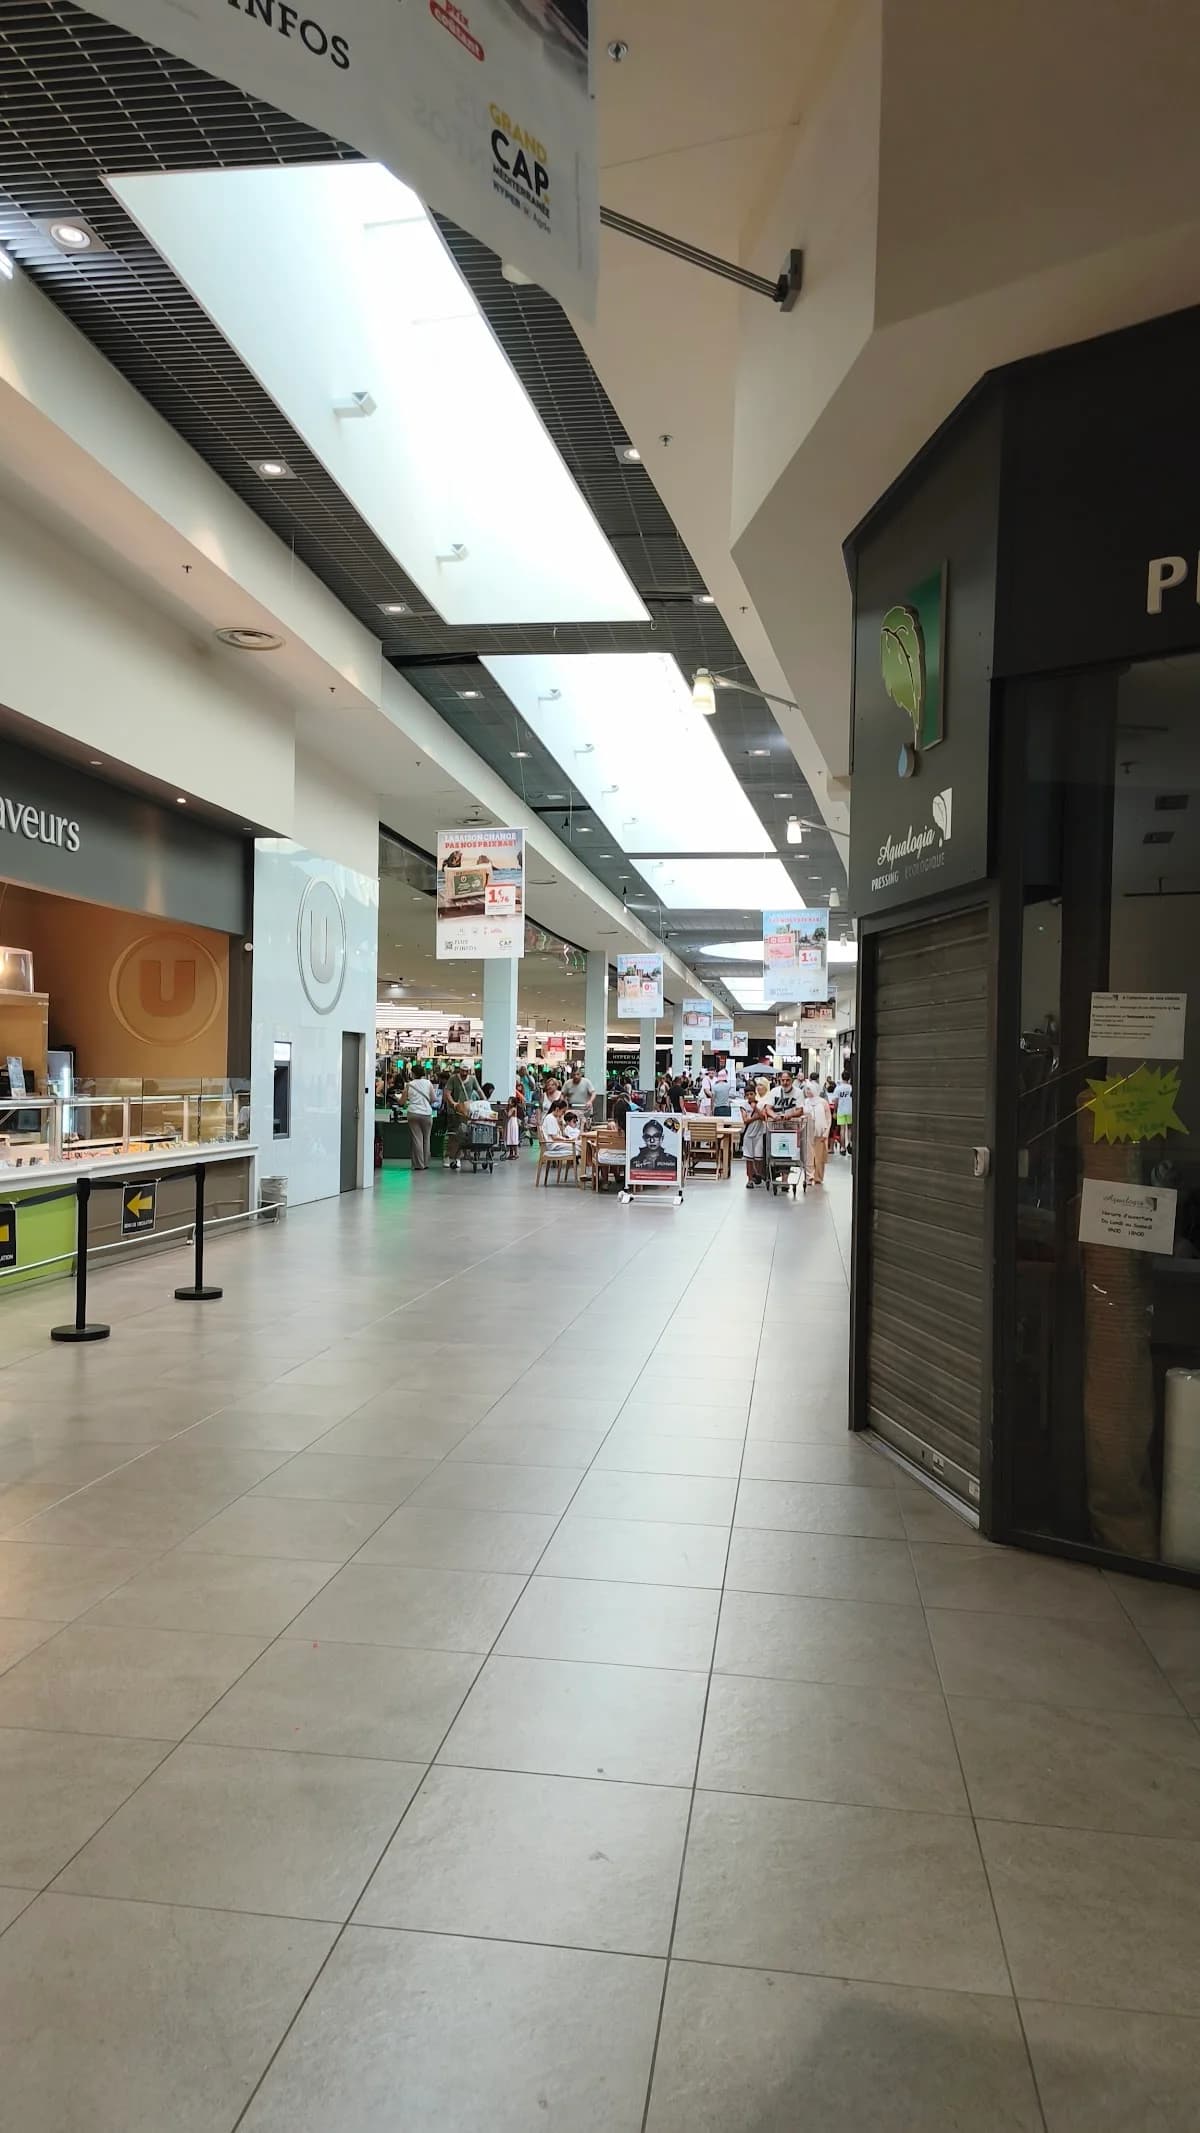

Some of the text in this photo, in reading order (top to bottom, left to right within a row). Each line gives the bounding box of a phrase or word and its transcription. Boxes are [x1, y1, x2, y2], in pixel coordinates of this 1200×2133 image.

[227, 0, 350, 69] NFOS
[489, 101, 548, 165] GRAND
[491, 129, 549, 197] CAP
[1146, 549, 1200, 615] P
[877, 824, 936, 870] Aqualogia
[871, 870, 899, 892] PRESSING
